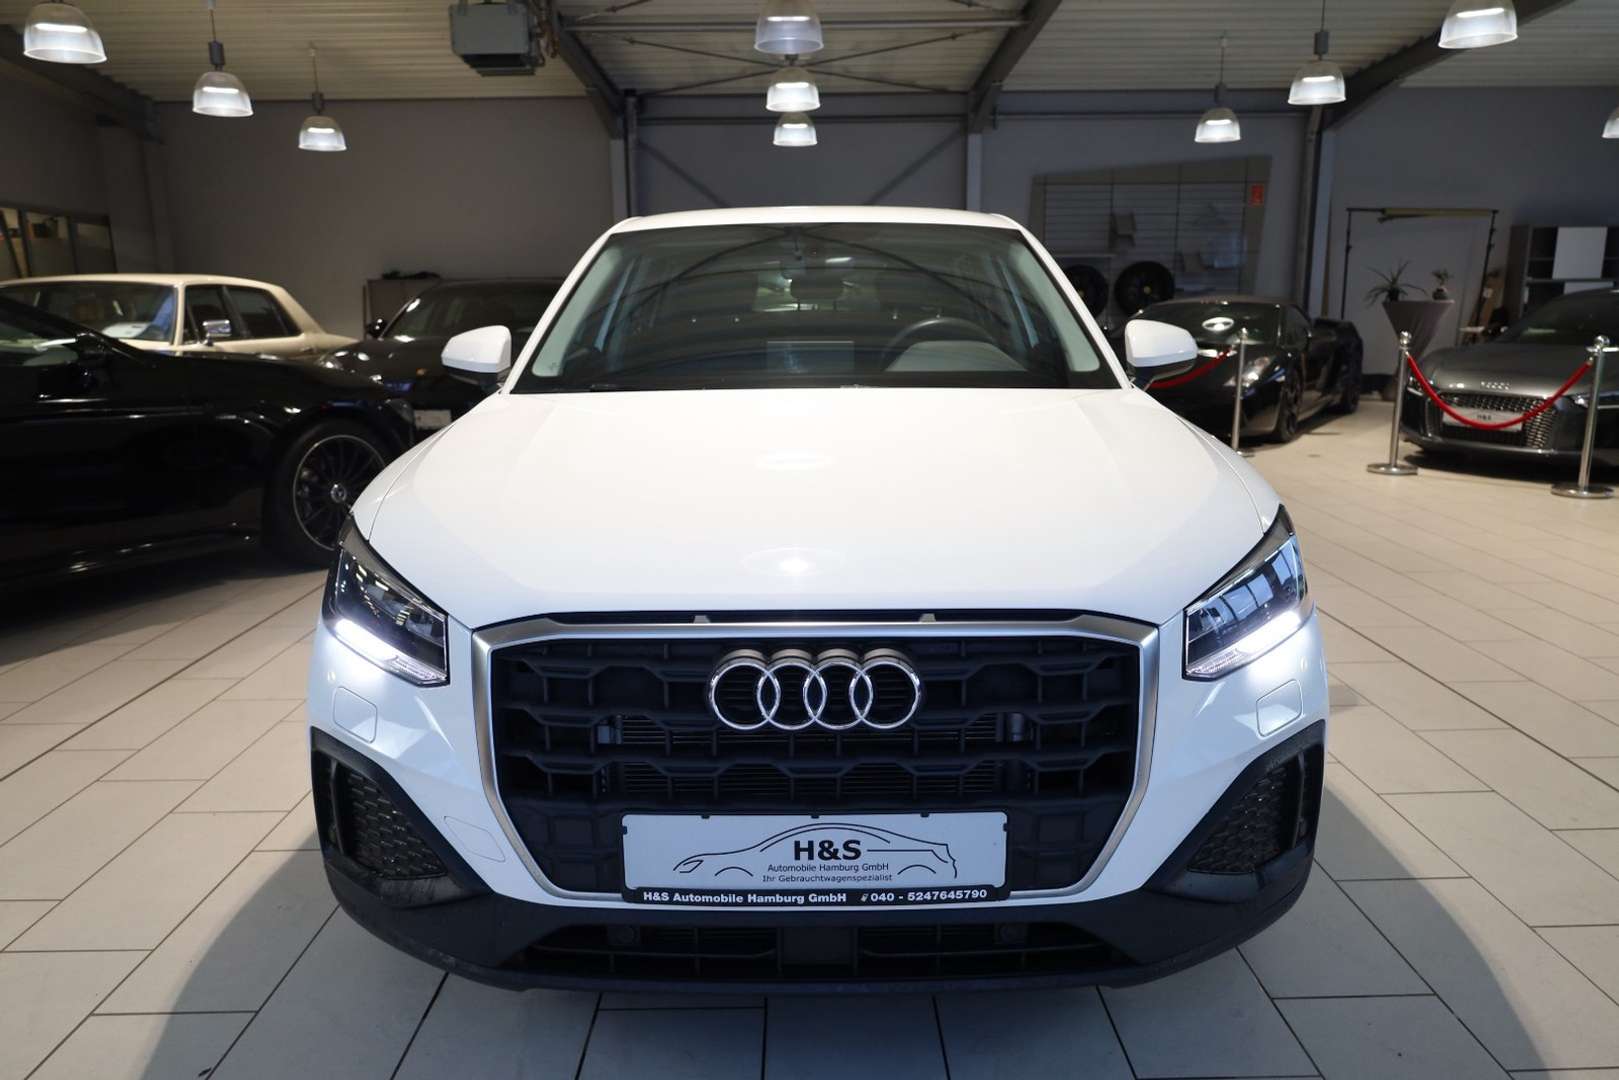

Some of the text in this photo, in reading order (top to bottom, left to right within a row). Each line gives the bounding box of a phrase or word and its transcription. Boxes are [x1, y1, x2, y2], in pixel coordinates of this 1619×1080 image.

[794, 839, 861, 861] H&S
[767, 863, 889, 873] Automobile Hamburg GmbH
[762, 874, 893, 883] Ihr Gebrauchtwagenspezialist
[643, 891, 669, 901] H&S
[673, 892, 744, 903] Automobile
[748, 893, 805, 904] Hamburg
[809, 893, 846, 903] GmbH
[870, 893, 895, 902] 040
[907, 889, 988, 901] 5247645790
